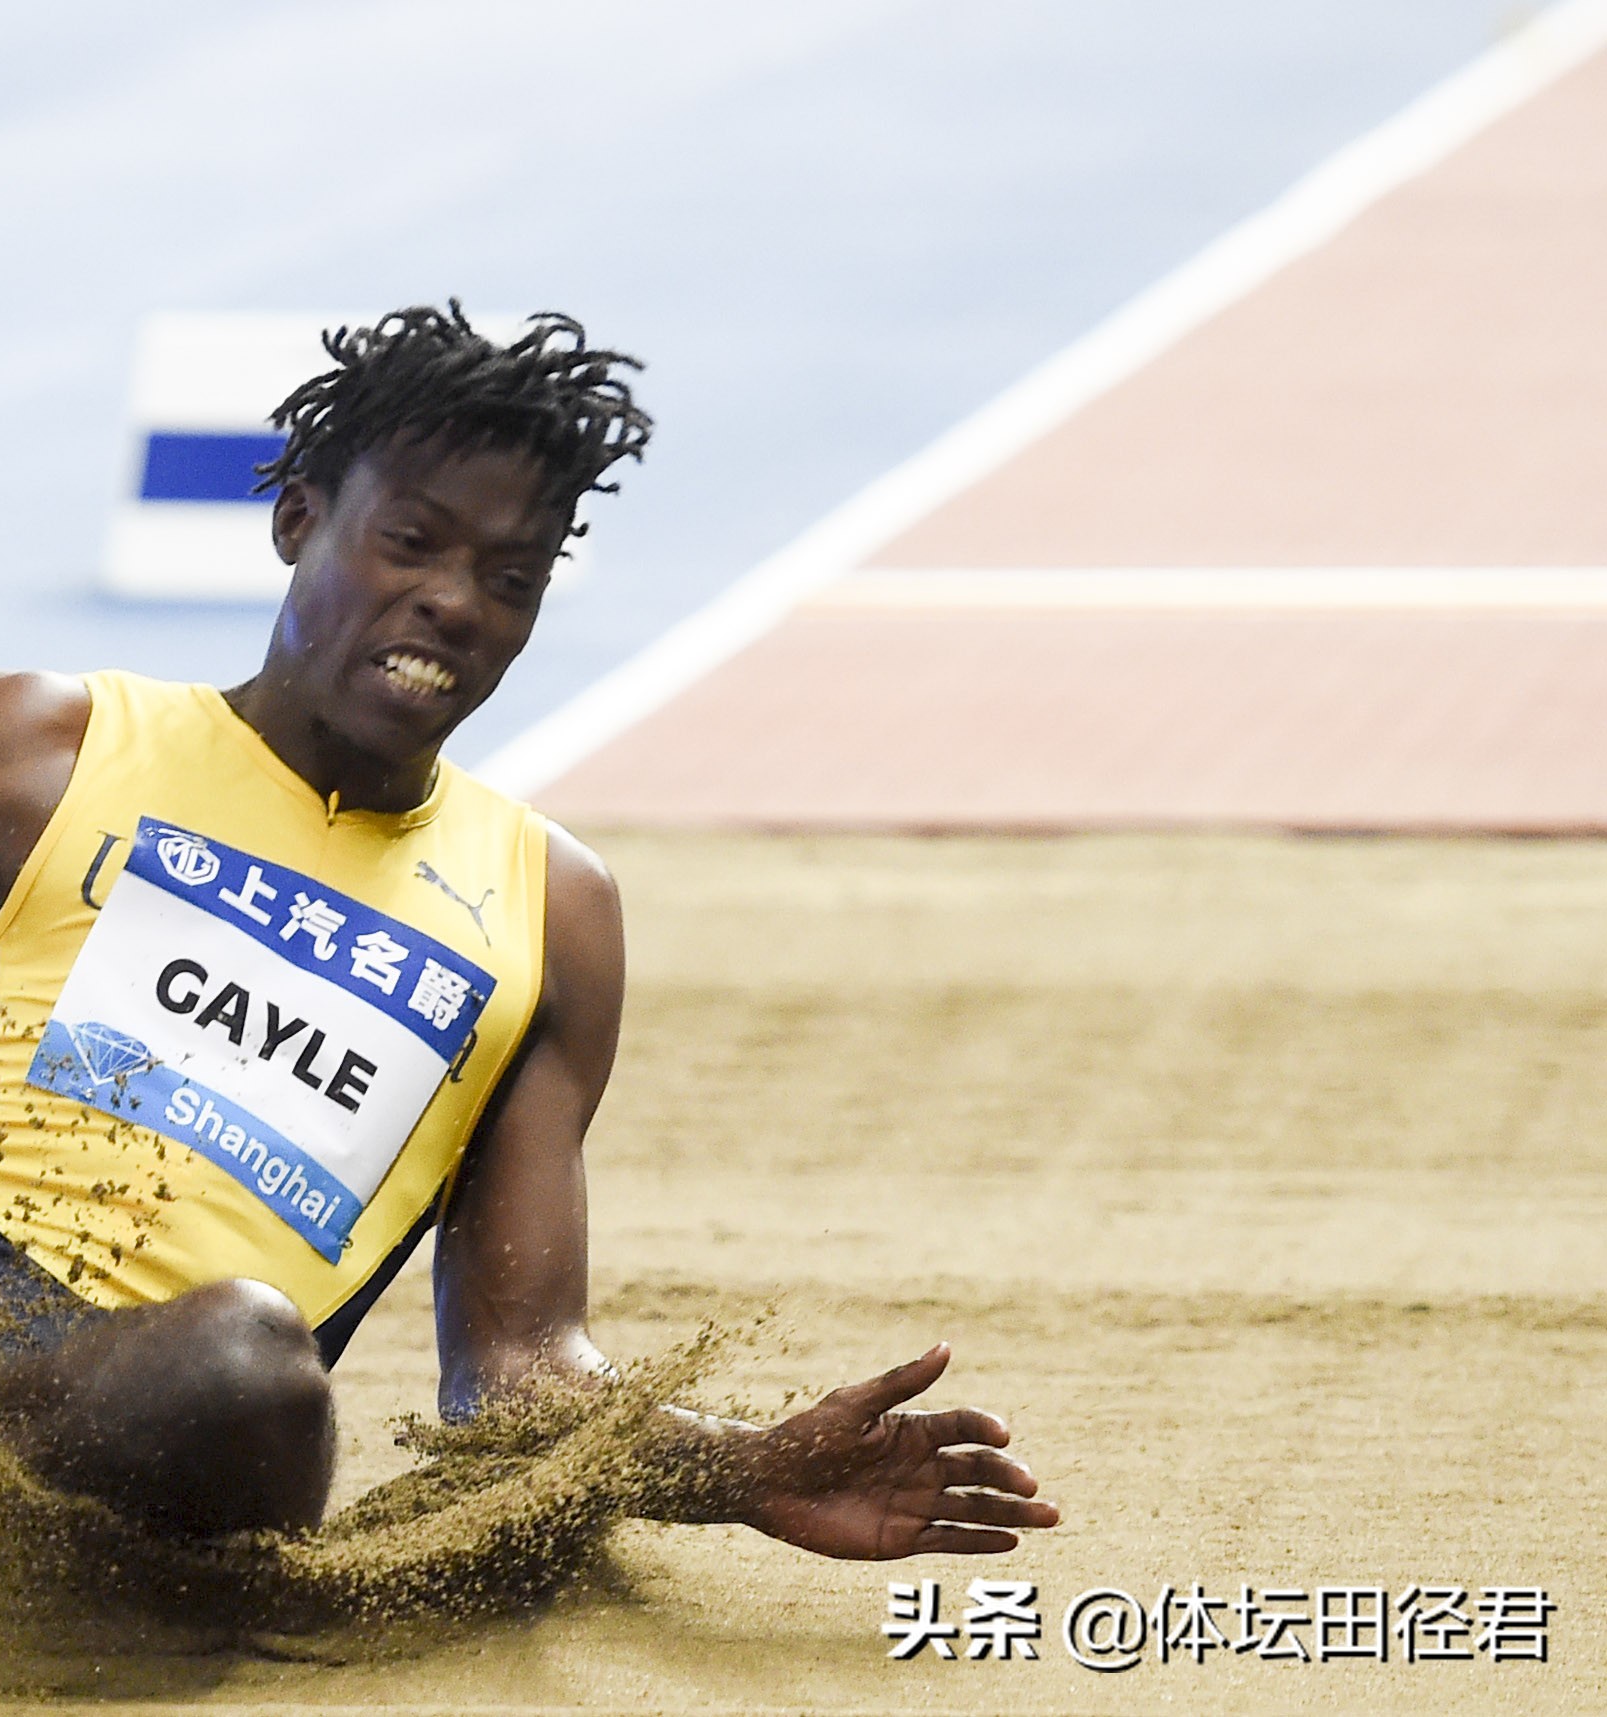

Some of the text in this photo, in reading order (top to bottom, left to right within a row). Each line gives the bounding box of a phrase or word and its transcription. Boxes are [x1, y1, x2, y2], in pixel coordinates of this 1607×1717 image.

[218, 865, 472, 1031] 上汽名爵
[155, 957, 378, 1115] GAYLE
[164, 1087, 342, 1230] Shanghai
